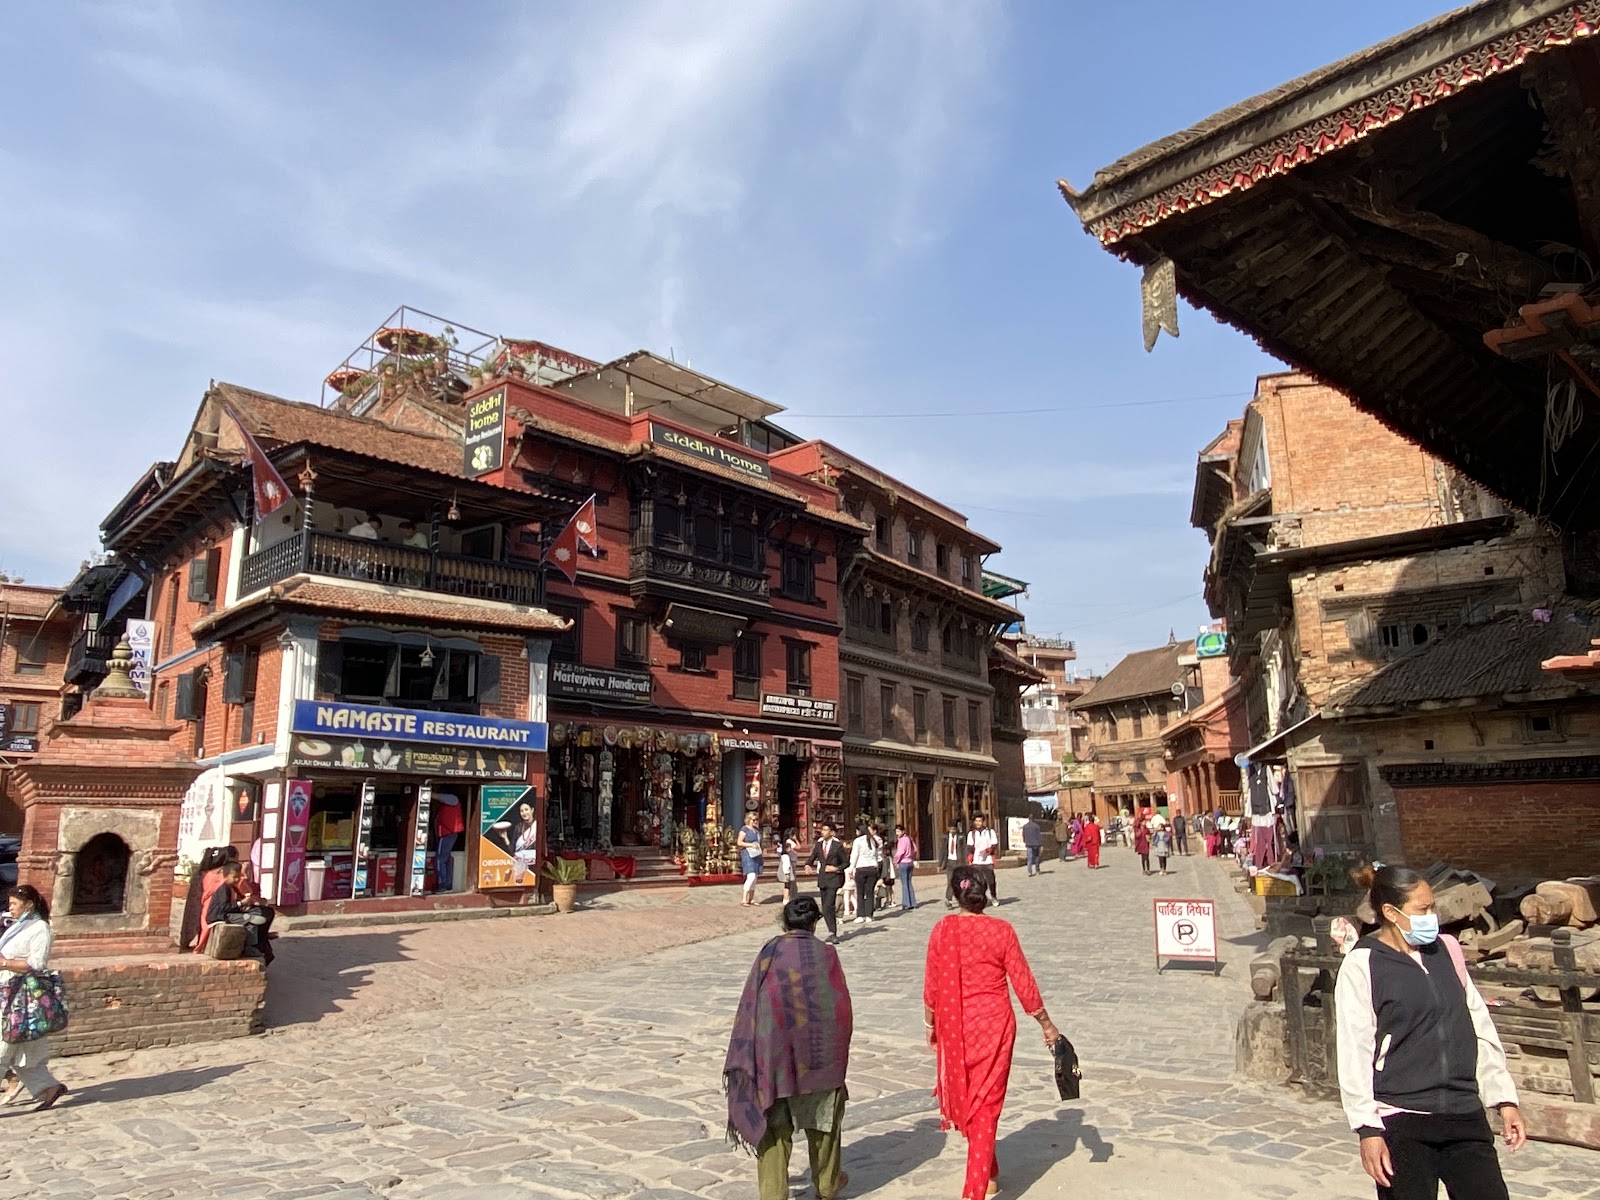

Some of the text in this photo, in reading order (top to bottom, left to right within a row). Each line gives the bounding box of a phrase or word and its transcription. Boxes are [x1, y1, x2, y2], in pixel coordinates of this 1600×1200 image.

[470, 412, 499, 431] home
[719, 449, 762, 473] home
[553, 669, 605, 687] Masterpiece
[608, 676, 650, 693] Handicraft
[316, 706, 530, 742] NAMASTE RESTAURANT
[723, 738, 763, 749] WELCOME
